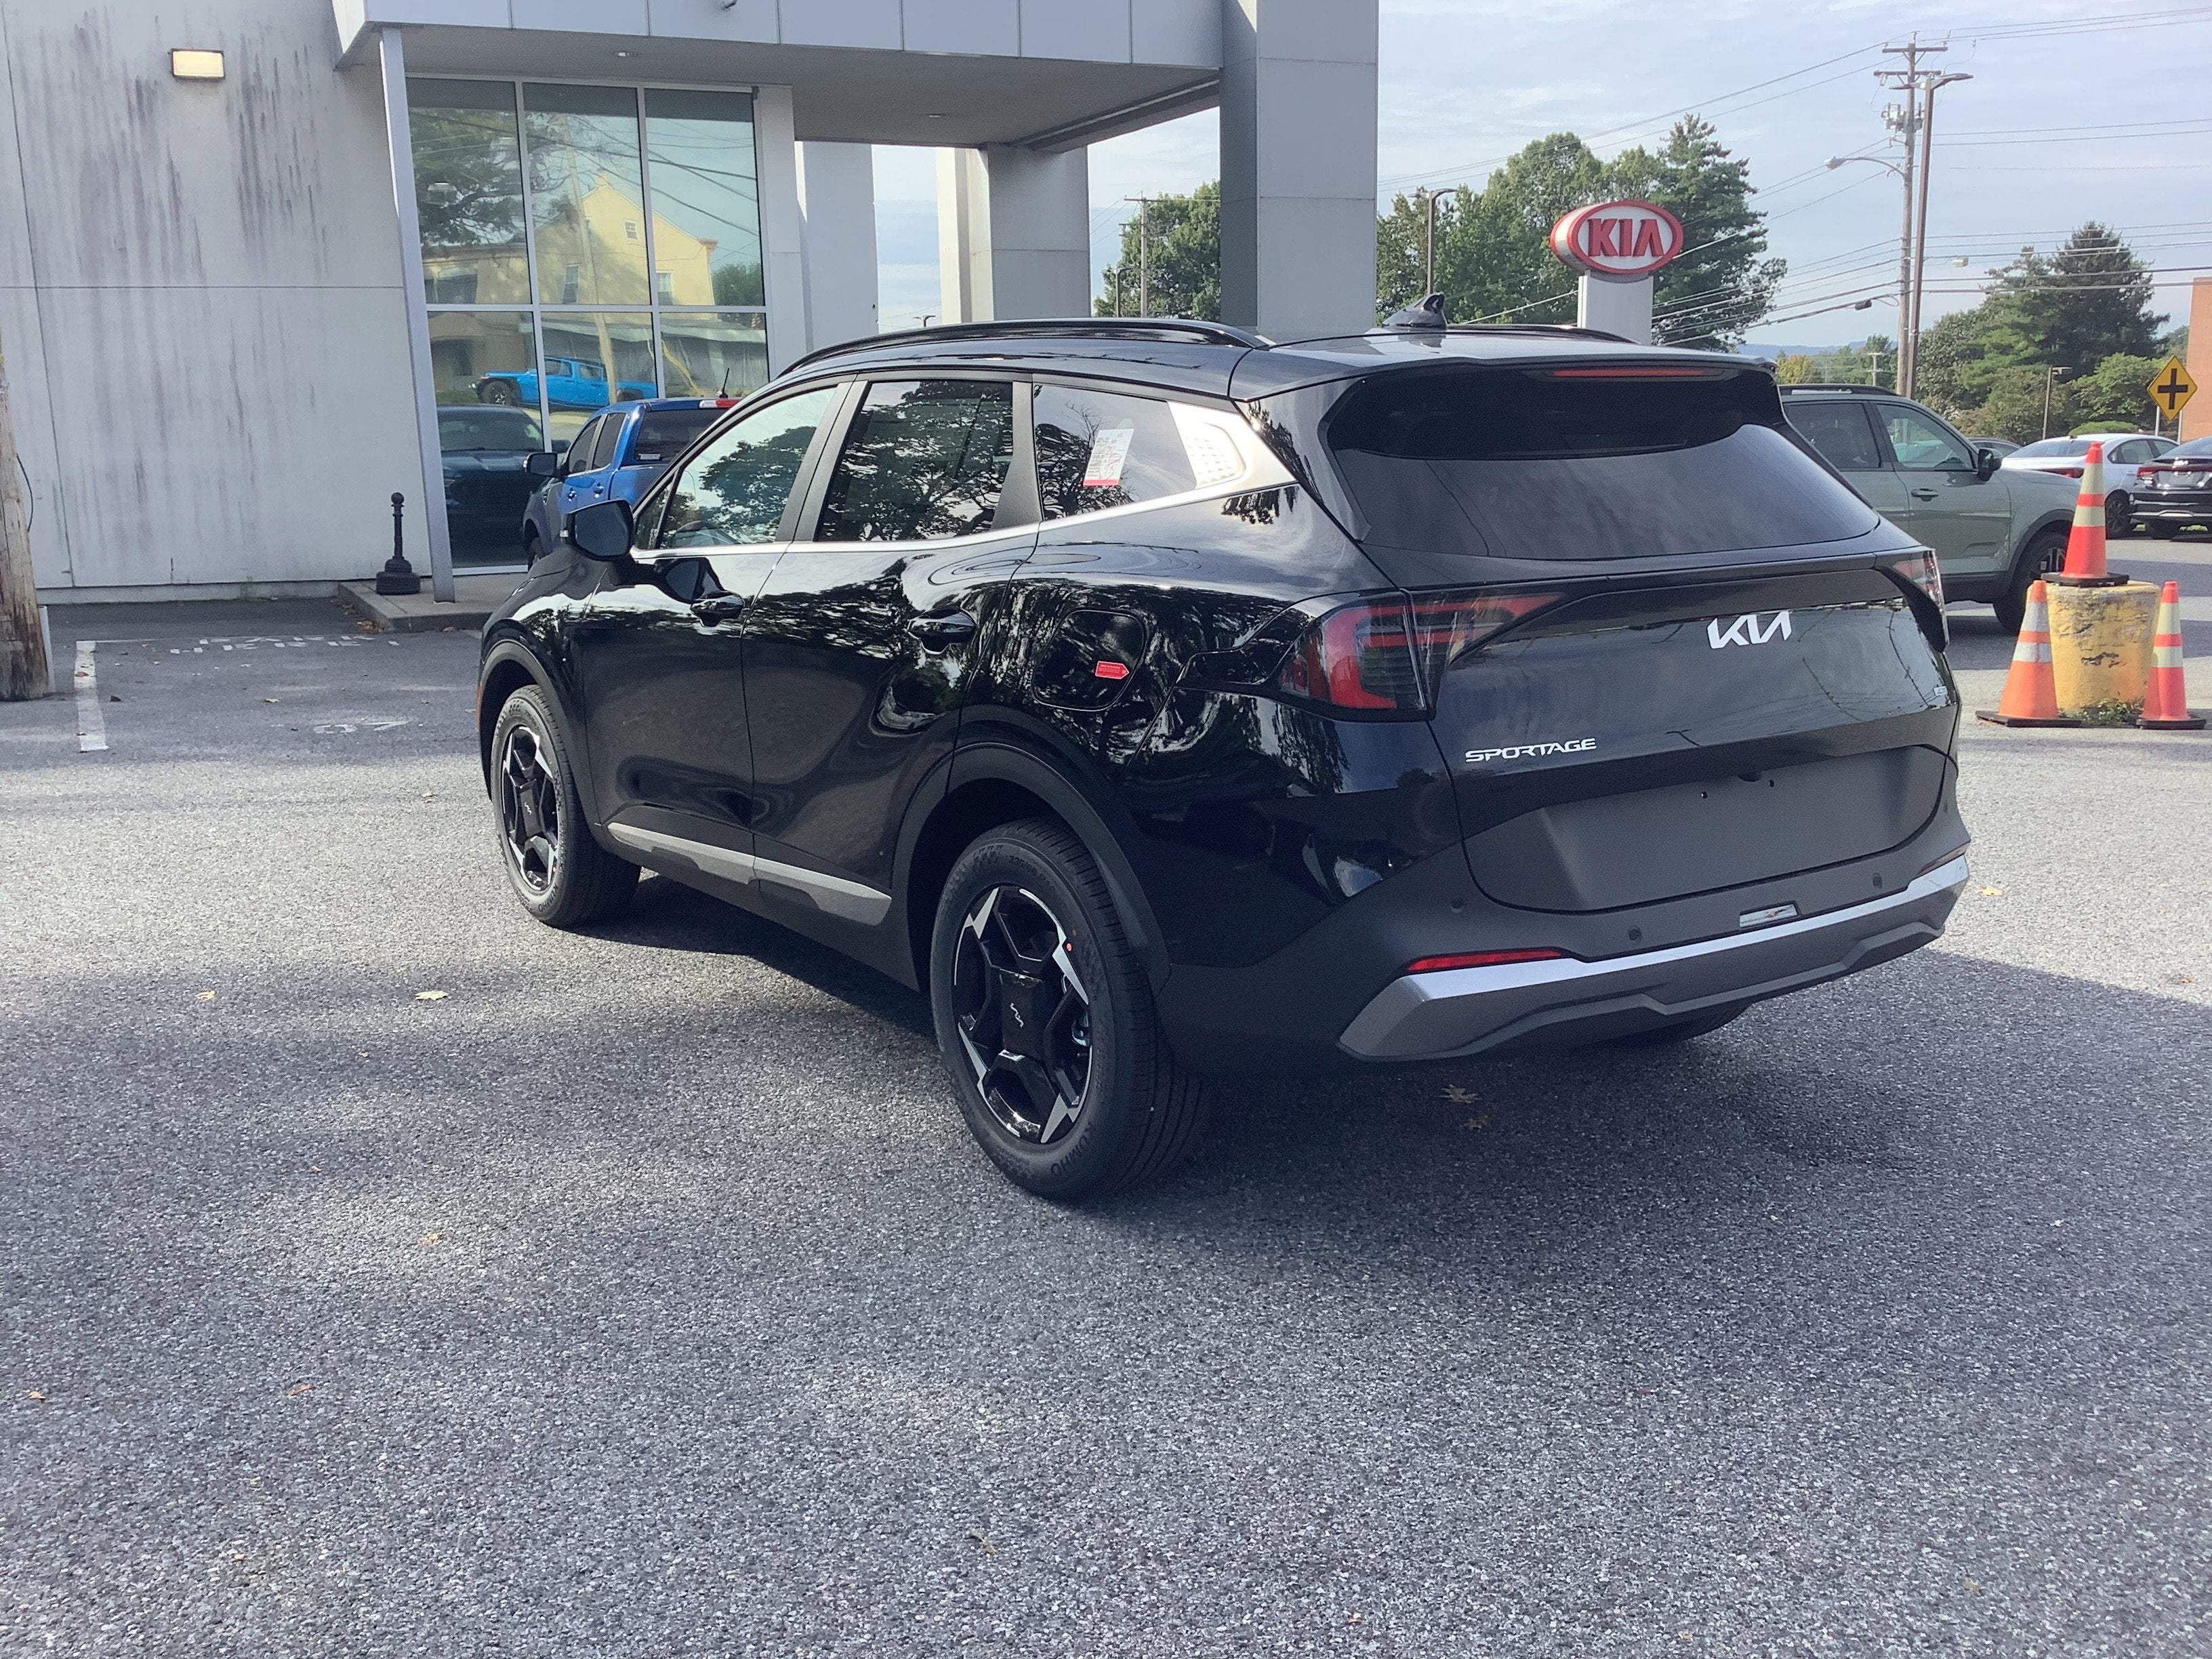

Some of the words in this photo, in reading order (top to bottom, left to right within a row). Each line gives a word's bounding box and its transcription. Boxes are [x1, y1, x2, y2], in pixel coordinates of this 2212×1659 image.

[1587, 218, 1664, 257] KIA
[1707, 610, 1791, 649] KIA
[1465, 738, 1597, 762] SPORTAGE
[1050, 1122, 1097, 1176] KUMHO
